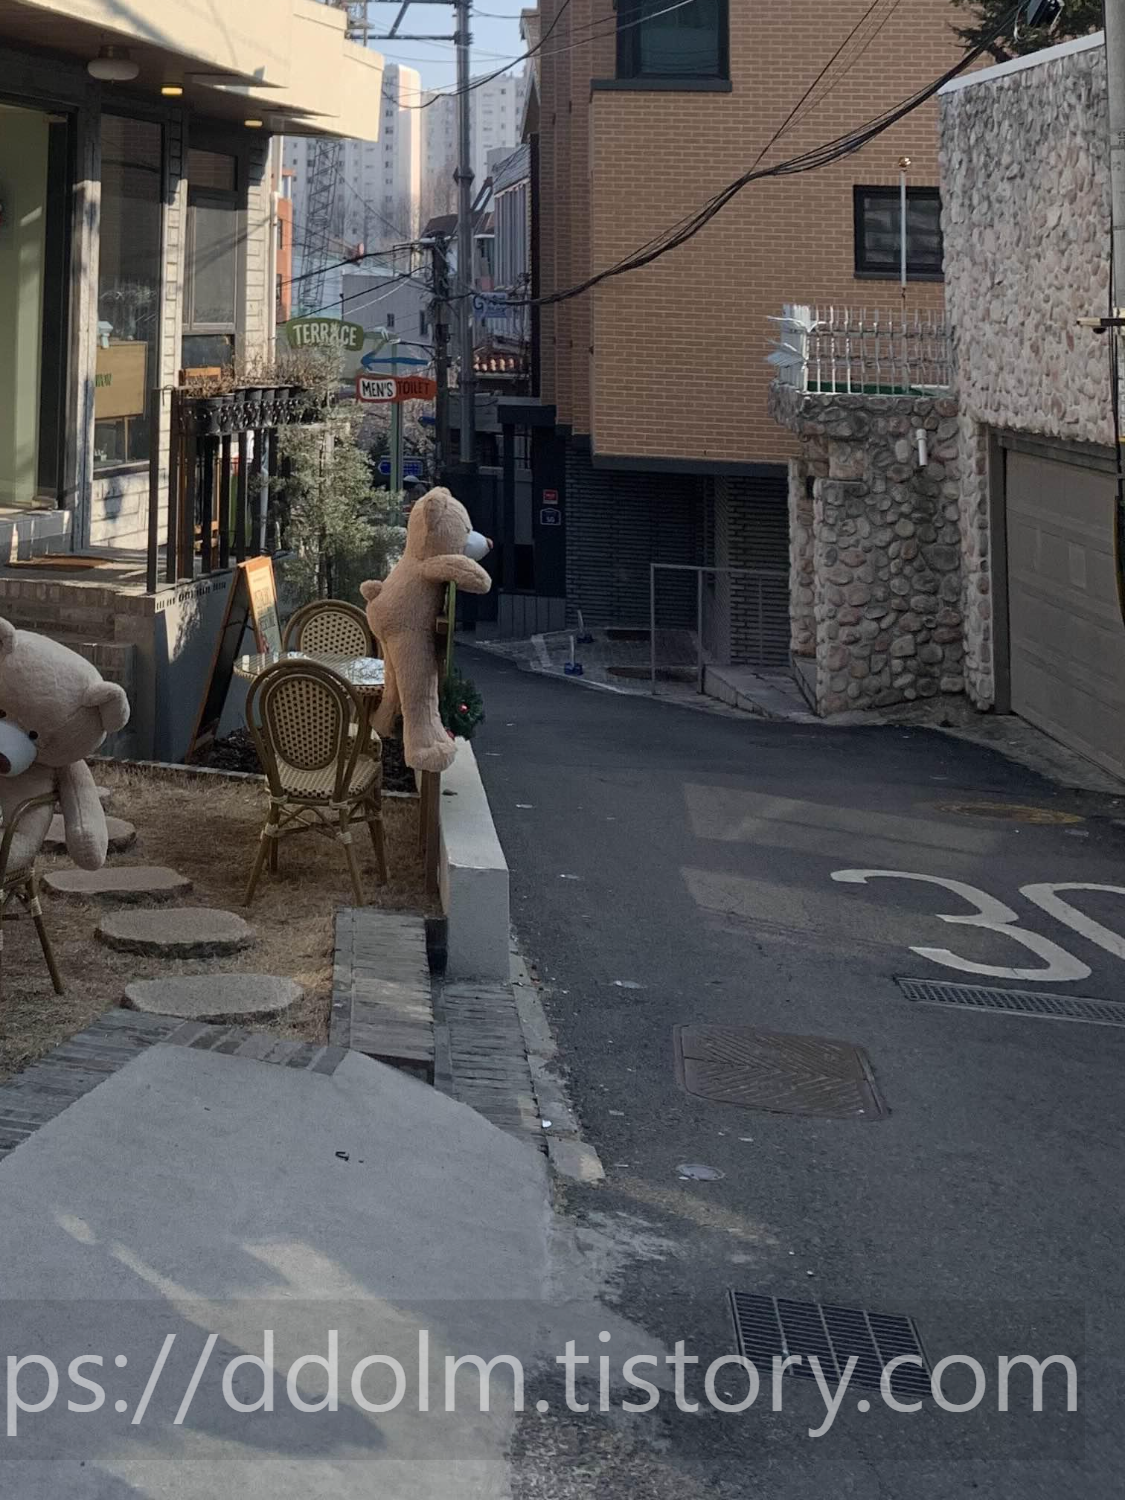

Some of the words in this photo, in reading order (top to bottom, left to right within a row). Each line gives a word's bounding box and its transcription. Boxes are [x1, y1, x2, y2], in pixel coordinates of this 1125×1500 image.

[293, 321, 357, 347] TERRACE
[361, 380, 394, 398] MEN'S
[397, 382, 430, 396] TOILET
